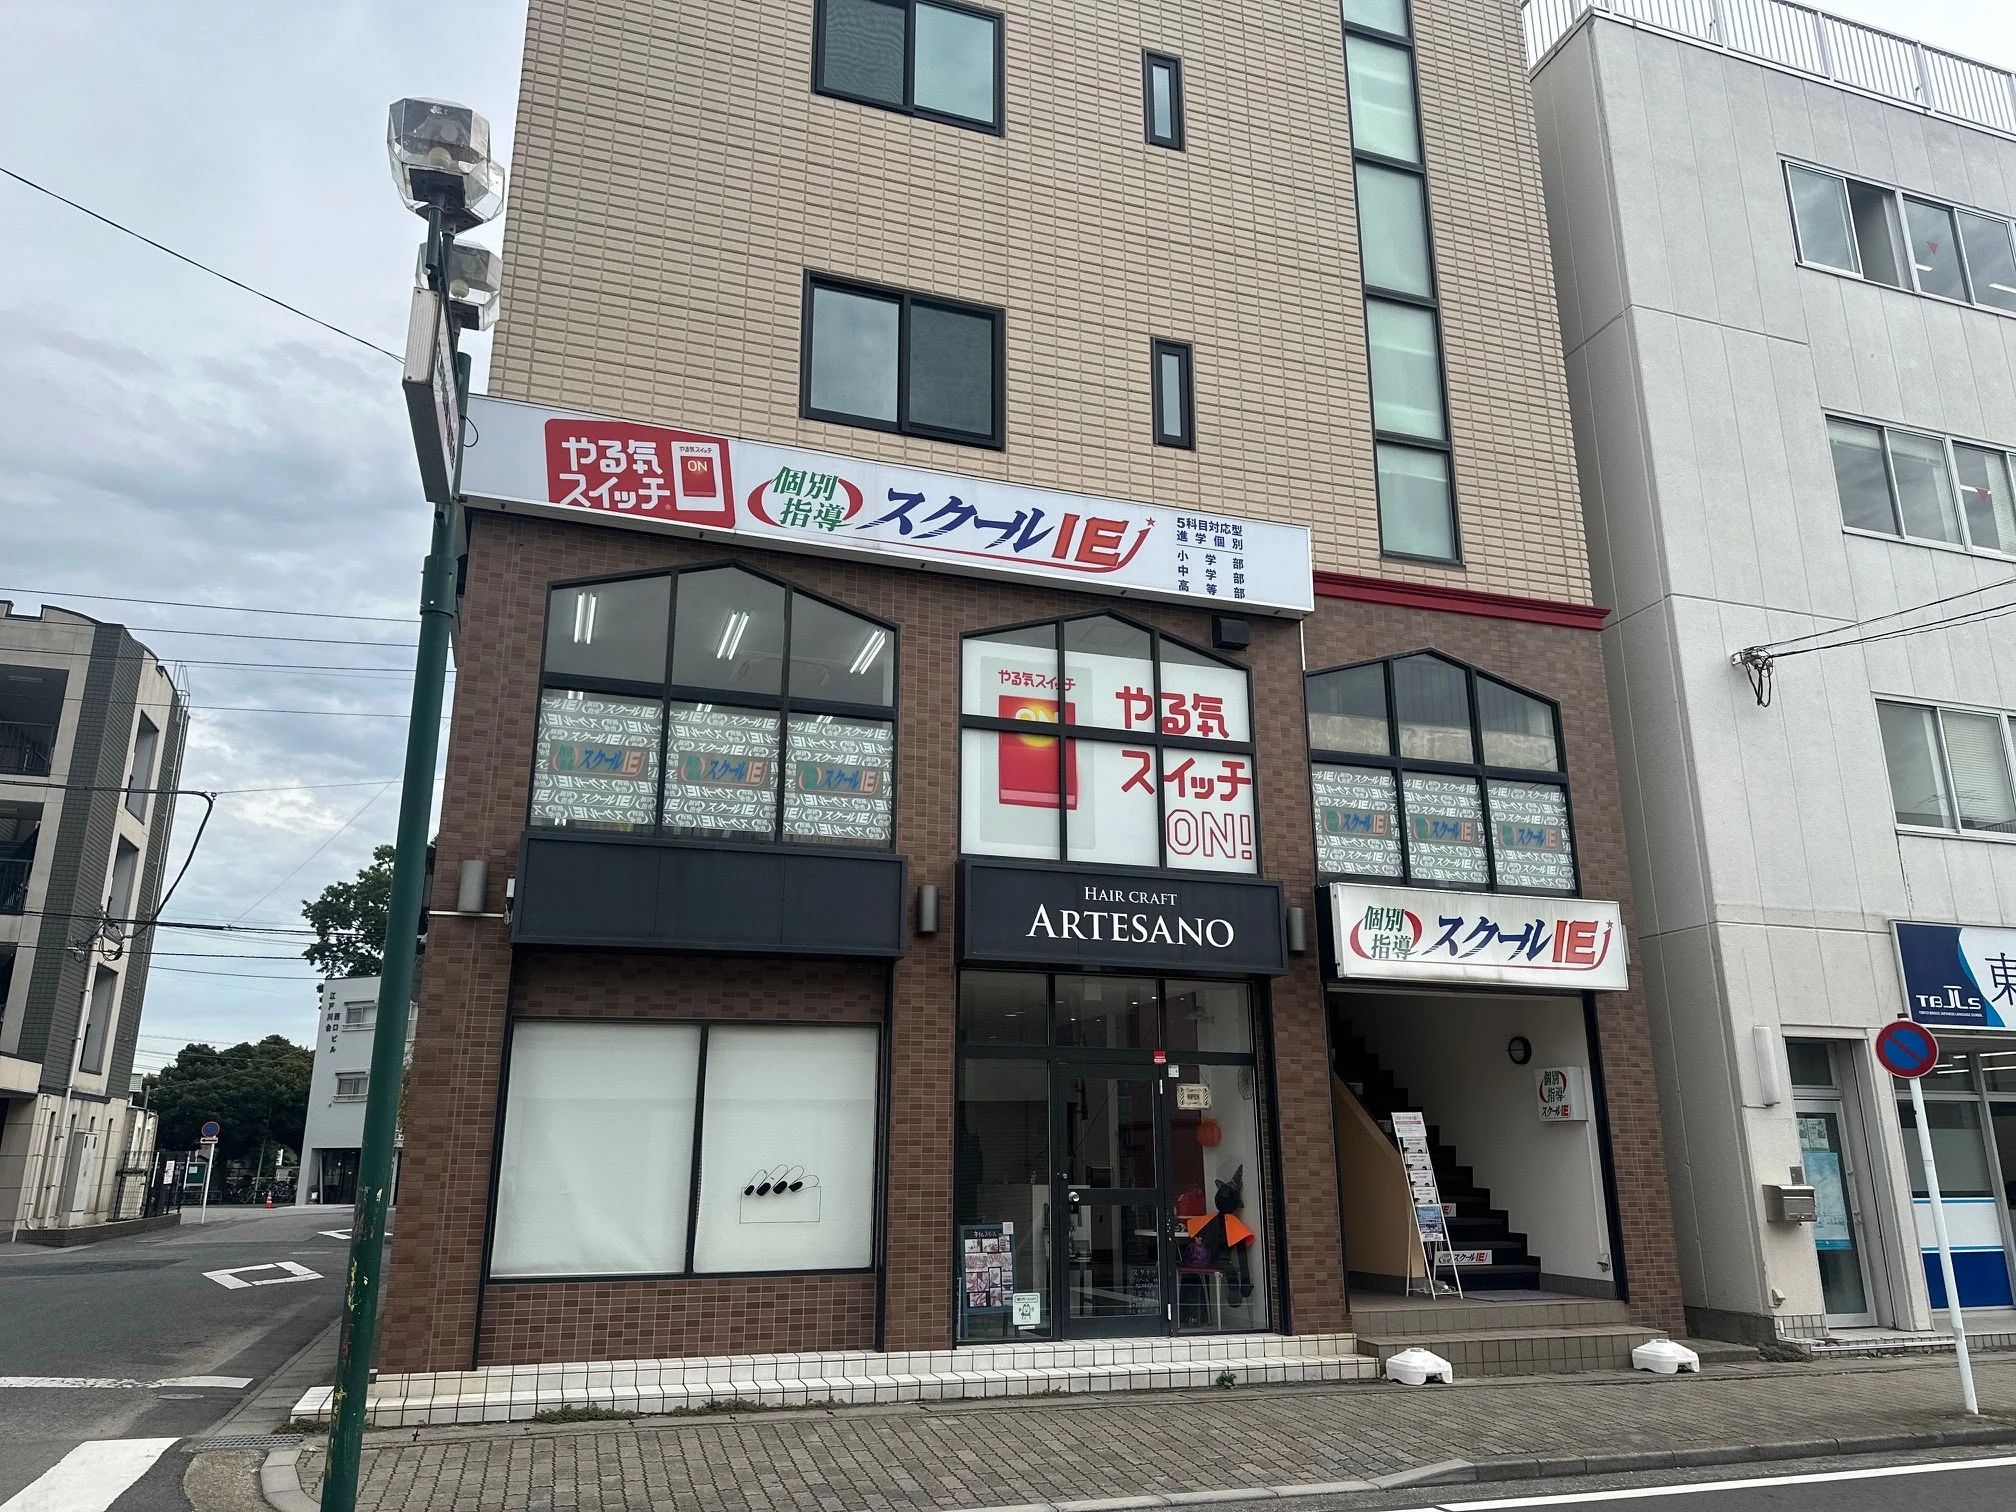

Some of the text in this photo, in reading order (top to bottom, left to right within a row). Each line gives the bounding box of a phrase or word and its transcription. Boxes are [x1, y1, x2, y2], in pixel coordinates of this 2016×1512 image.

[561, 437, 664, 476] やる気
[687, 460, 707, 472] ON
[559, 474, 670, 510] スイッチ
[770, 465, 841, 501] 個別
[780, 498, 850, 532] 指導
[1176, 516, 1243, 537] 5科目対応型
[1176, 530, 1243, 550] 進学個別
[998, 669, 1076, 691] やる気スイチ
[1115, 686, 1230, 739] やる気
[1121, 749, 1252, 802] スイッチ
[1166, 808, 1252, 860] ON!
[1129, 891, 1177, 906] CRAFT
[1364, 905, 1405, 931] 個別
[1371, 933, 1413, 960] 指導
